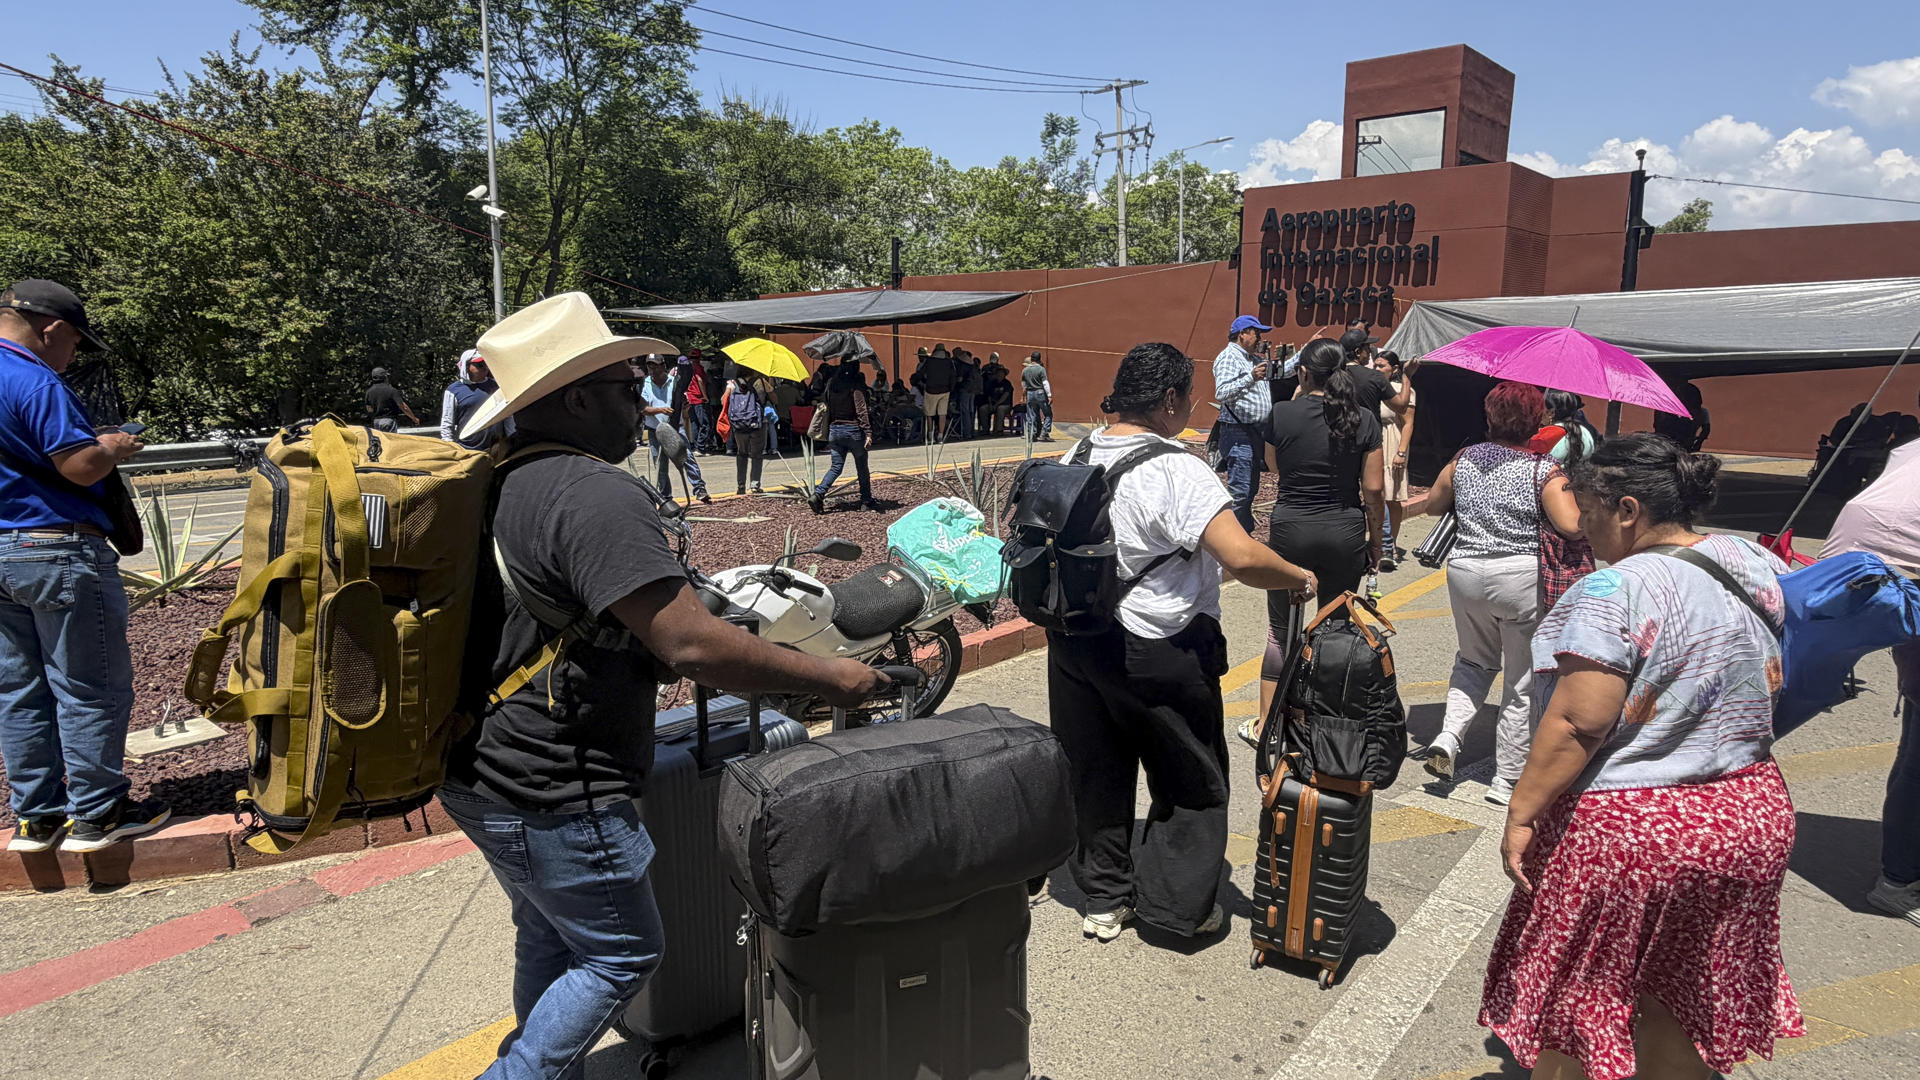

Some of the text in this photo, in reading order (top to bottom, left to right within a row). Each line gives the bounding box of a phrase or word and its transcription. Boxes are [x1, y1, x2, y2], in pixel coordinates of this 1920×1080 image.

[1261, 200, 1416, 234] Aeropuerto
[1260, 236, 1439, 270] Internacional
[1258, 281, 1395, 305] de Oaxaca
